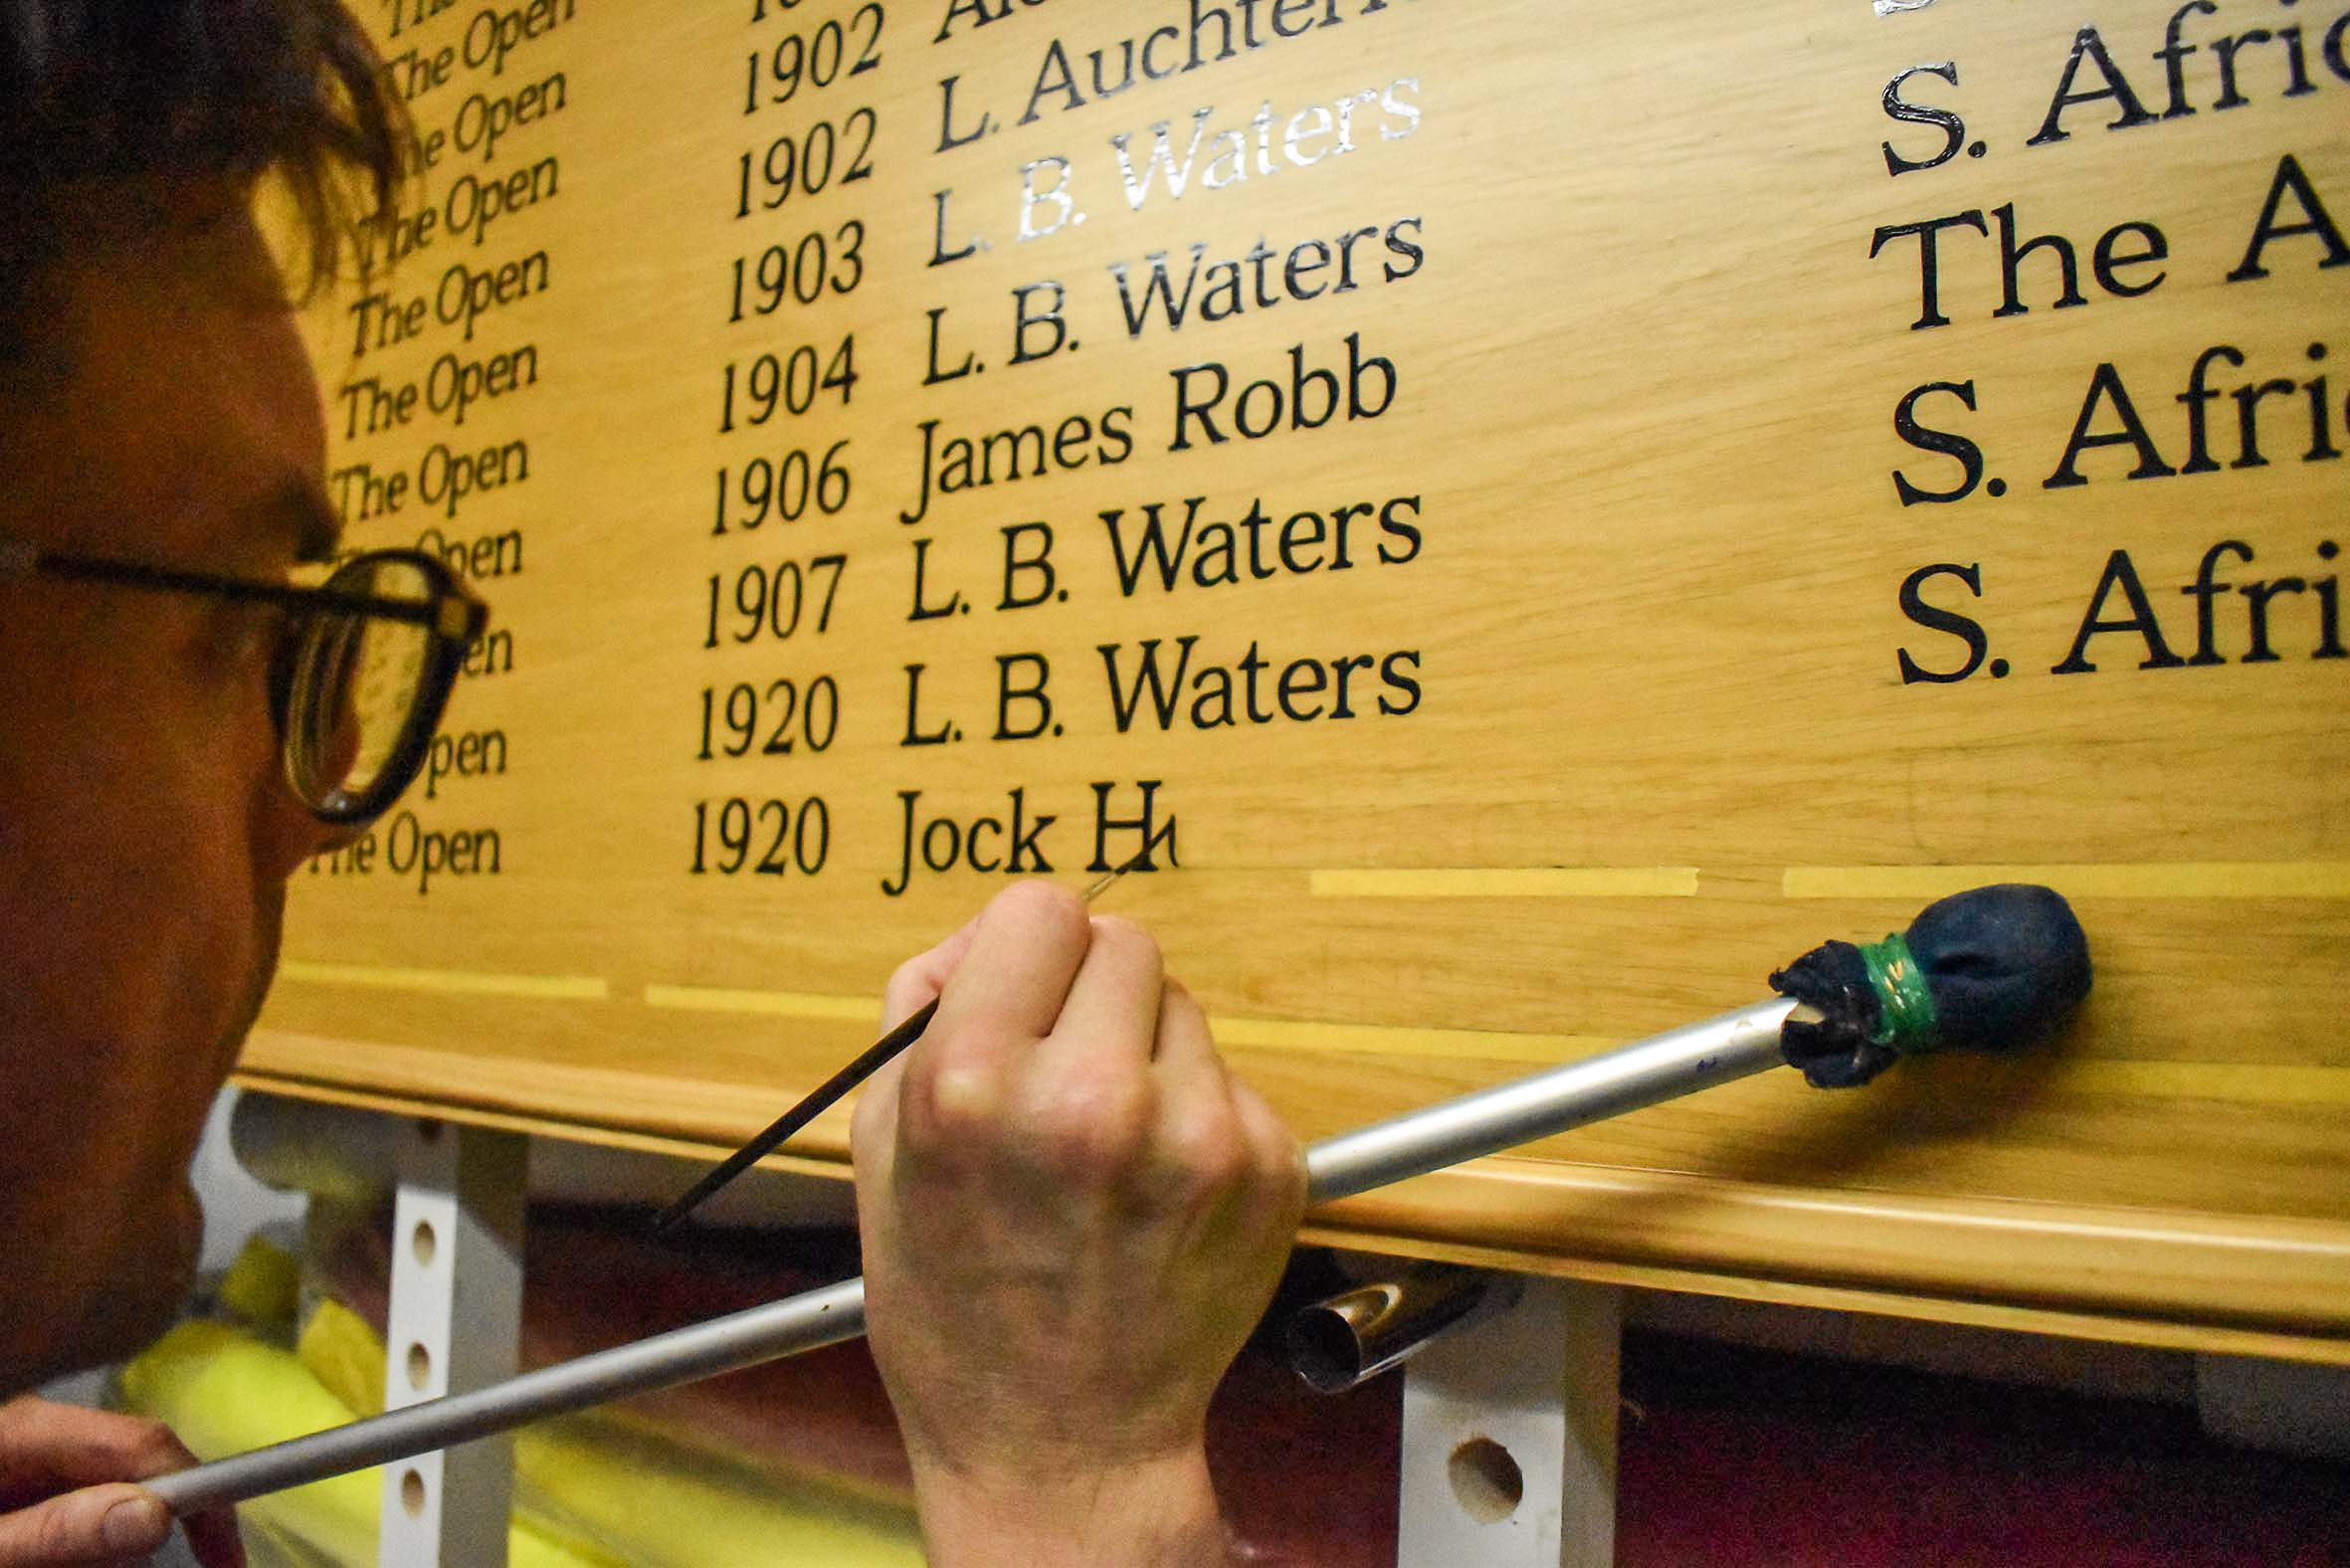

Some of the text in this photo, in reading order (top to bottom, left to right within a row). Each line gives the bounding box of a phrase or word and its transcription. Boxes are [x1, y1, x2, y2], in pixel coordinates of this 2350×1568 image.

[462, 0, 575, 76] Open
[743, 3, 883, 115] 1902
[933, 76, 1000, 153] L.
[1017, 0, 1387, 126] Auchte
[454, 72, 566, 162] Open
[734, 106, 877, 219] 1902
[1880, 60, 1987, 177] S.
[445, 156, 558, 245] Open
[927, 77, 1422, 268] L. B. Waters
[350, 250, 549, 357] The Open
[727, 220, 866, 323] 1903
[922, 216, 1424, 387] L. B. Waters
[1868, 202, 2169, 330] The
[341, 344, 537, 441] The Open
[719, 332, 858, 434] 1904
[899, 332, 1398, 525] James Robb
[1891, 342, 2350, 507] S. Afri
[333, 439, 528, 528] The Open
[710, 440, 851, 536] 1906
[704, 554, 848, 649] 1907
[906, 495, 1423, 621] L. B. Waters
[1896, 562, 2010, 685] S.
[695, 675, 839, 761] 1920
[899, 635, 1423, 747] L. B. Waters
[427, 728, 507, 799] pen
[387, 811, 500, 894] Open
[688, 795, 830, 876] 1920
[881, 787, 1057, 897] Jock
